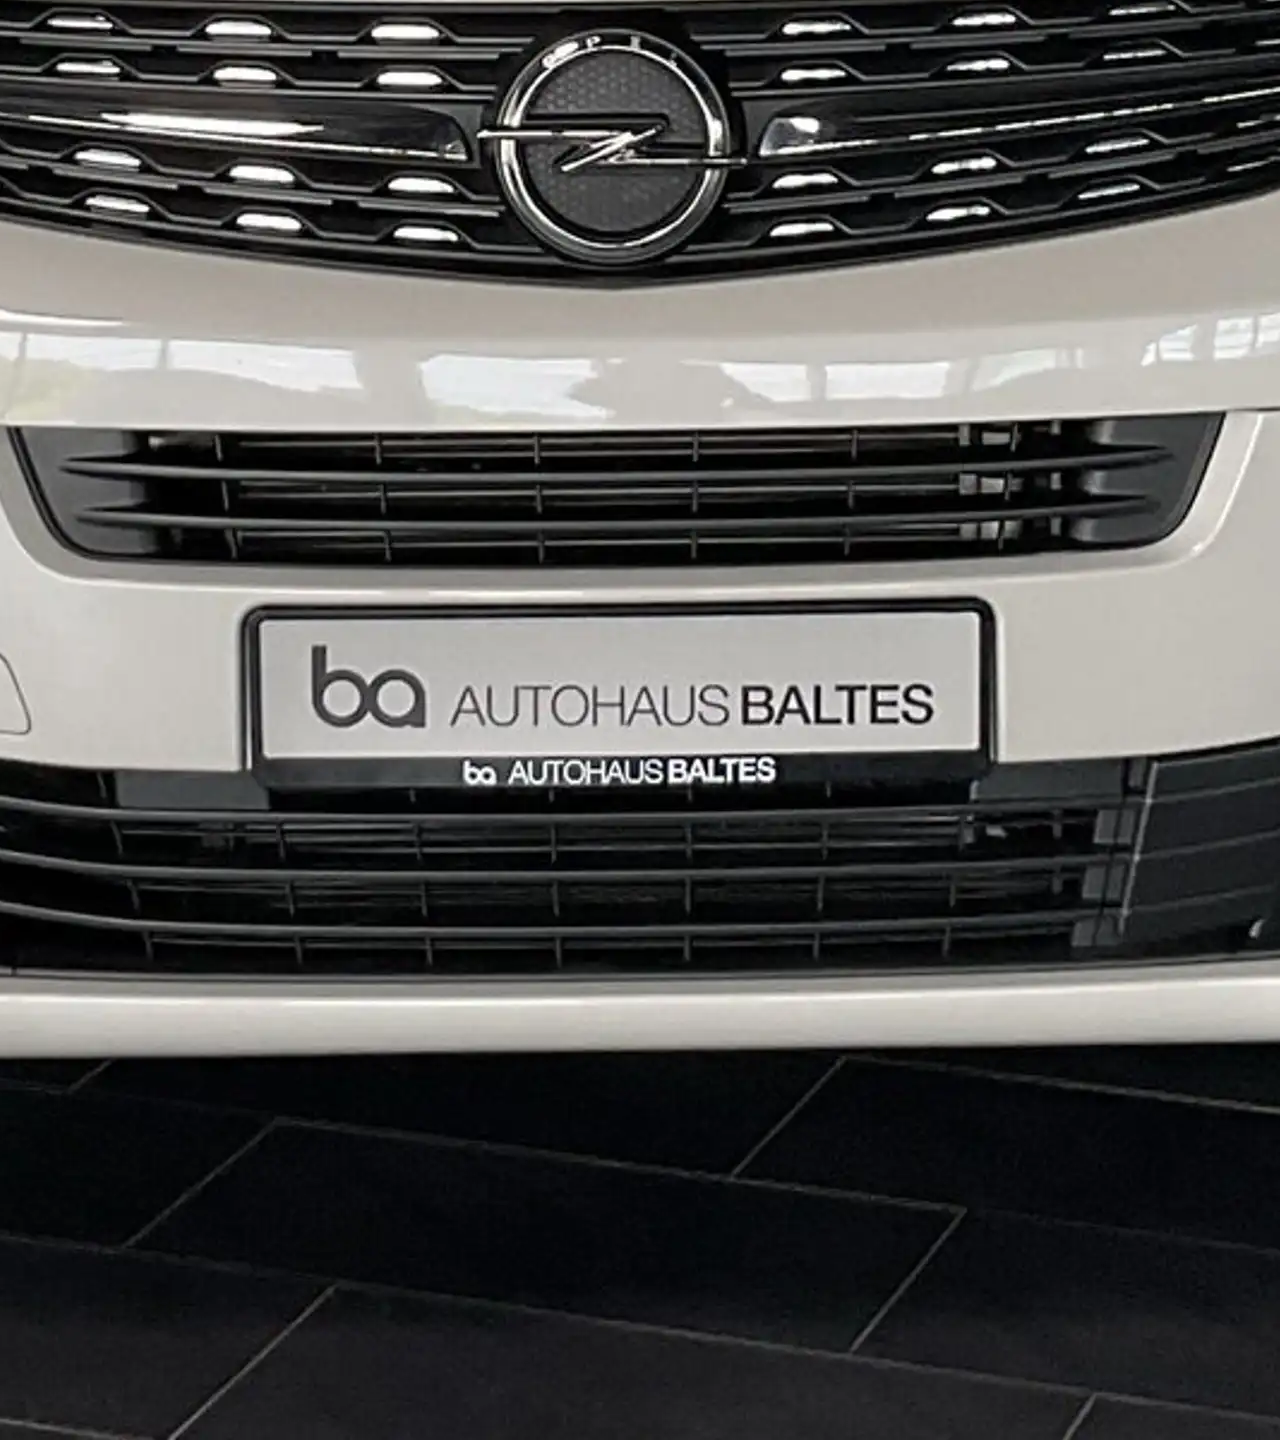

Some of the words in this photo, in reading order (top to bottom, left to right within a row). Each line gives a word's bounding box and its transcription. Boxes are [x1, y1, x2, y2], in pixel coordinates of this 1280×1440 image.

[311, 645, 426, 728] ba
[450, 683, 730, 727] AUTOHAUS
[741, 683, 935, 726] BALTES
[462, 760, 497, 785] ba
[508, 760, 665, 785] AUTOHAUS
[668, 757, 777, 784] BALTES
